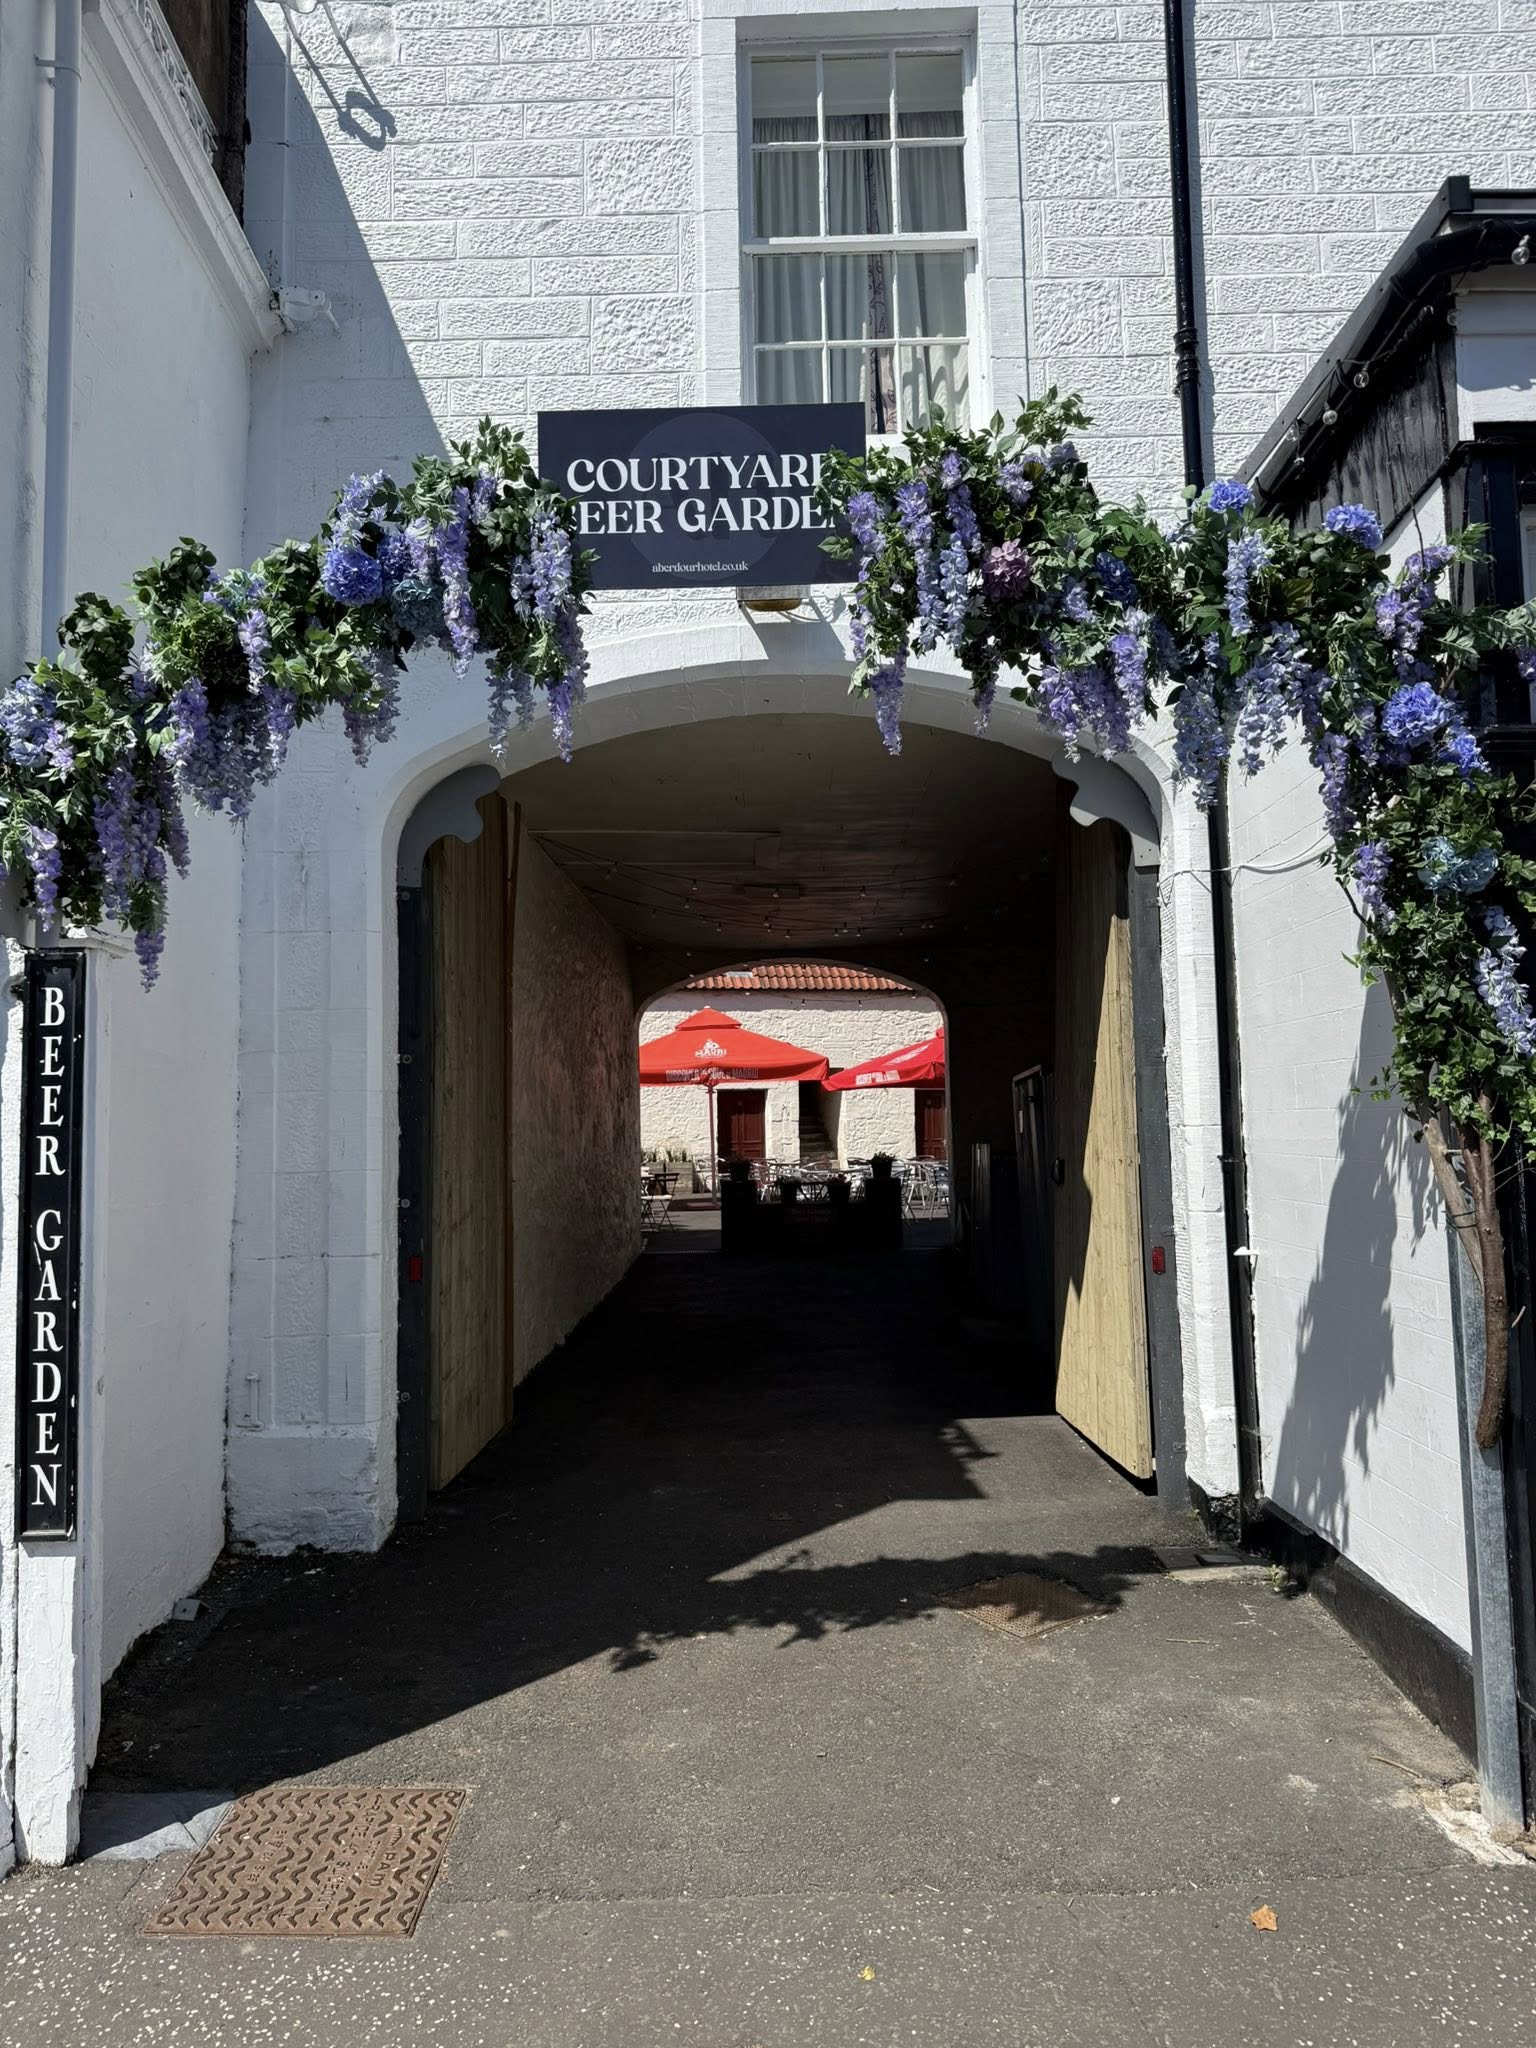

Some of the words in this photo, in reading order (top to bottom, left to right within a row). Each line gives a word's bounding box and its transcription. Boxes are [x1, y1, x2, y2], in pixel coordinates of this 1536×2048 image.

[570, 499, 664, 535] EER
[652, 561, 748, 573] aberdourhotel.co.uk
[34, 986, 67, 1176] BEER
[30, 1209, 65, 1506] GARDEN
